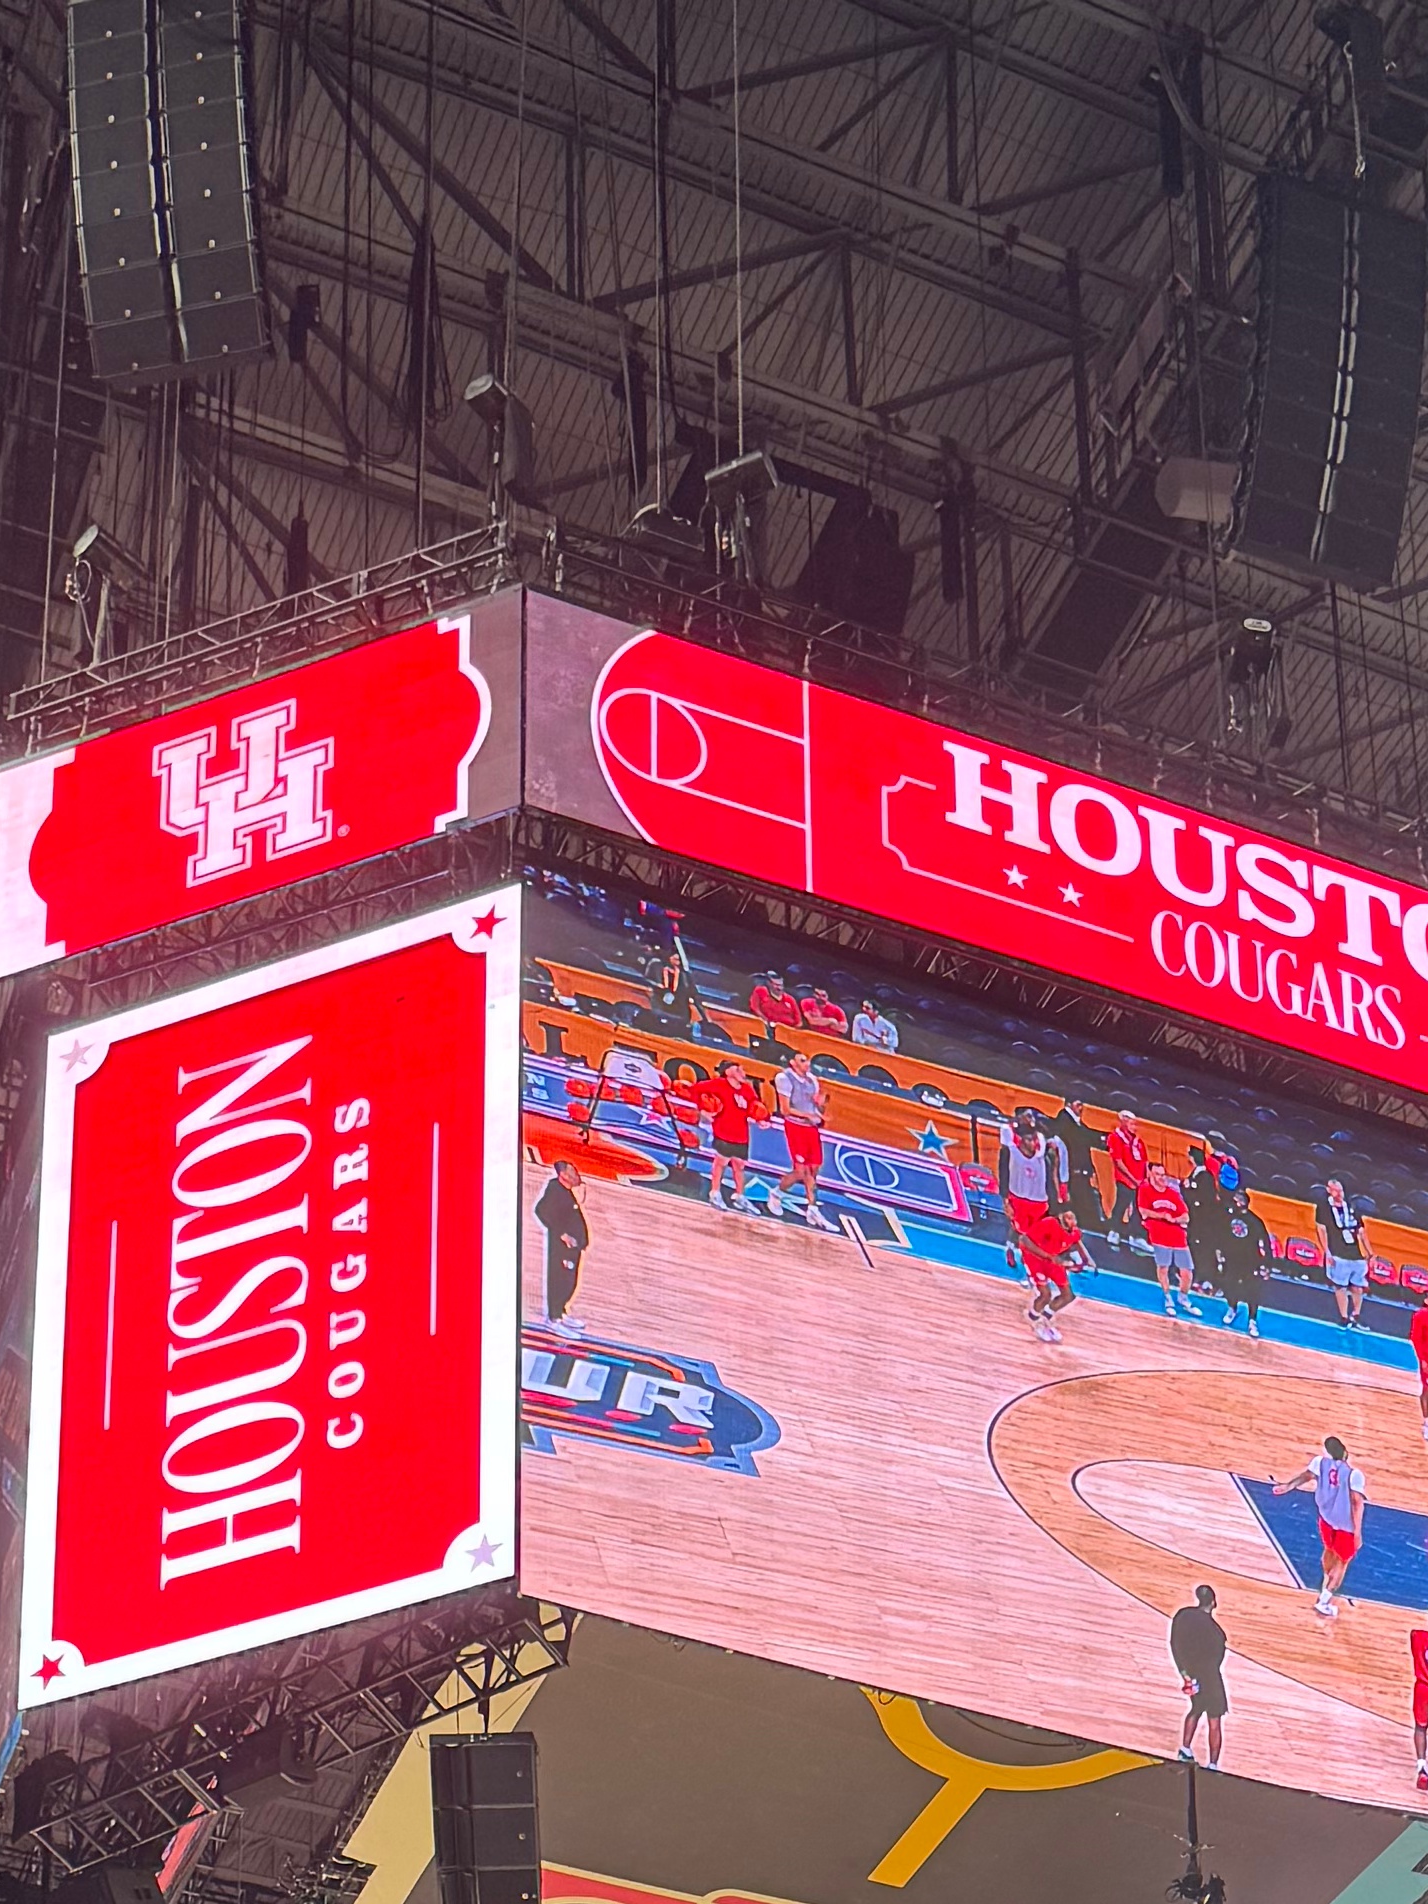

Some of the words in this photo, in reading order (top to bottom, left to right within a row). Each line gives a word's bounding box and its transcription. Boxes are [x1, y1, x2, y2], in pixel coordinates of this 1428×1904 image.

[152, 698, 334, 888] UH
[1152, 909, 1405, 1052] COUGARS
[161, 1034, 312, 1590] HOUSTON
[326, 1098, 371, 1450] COUGARS
